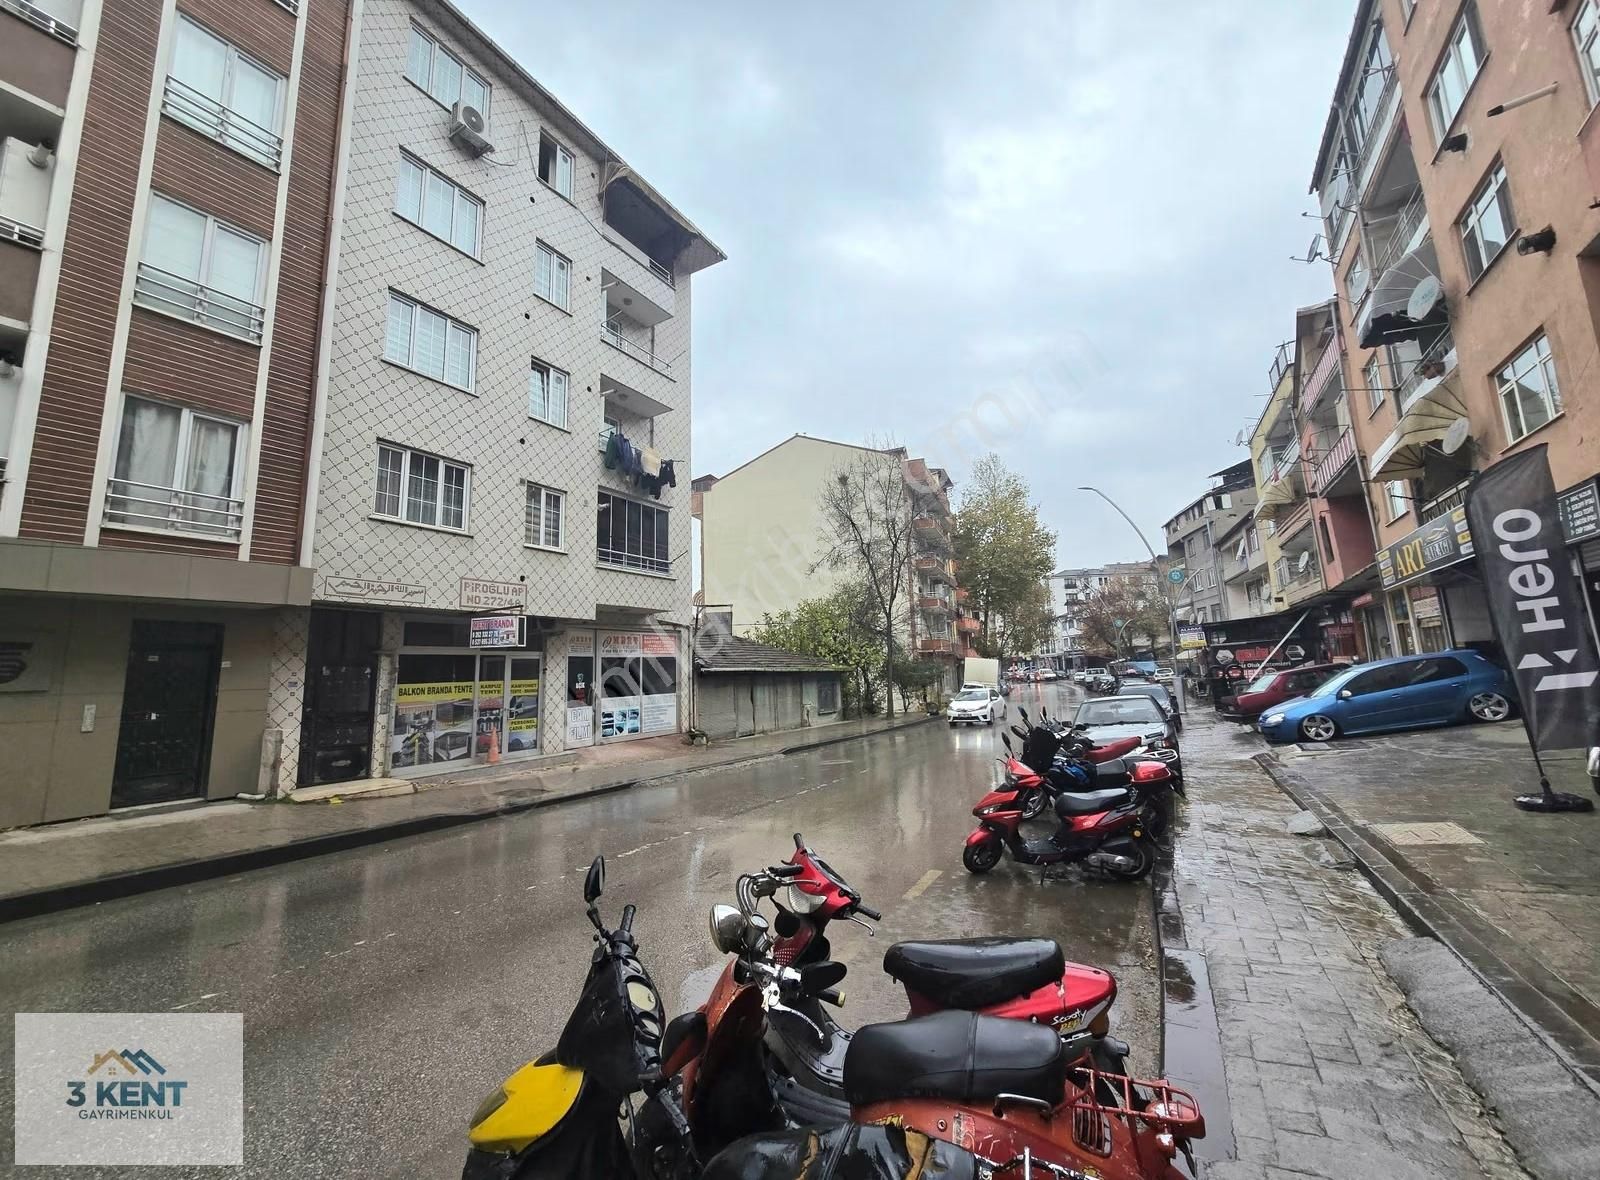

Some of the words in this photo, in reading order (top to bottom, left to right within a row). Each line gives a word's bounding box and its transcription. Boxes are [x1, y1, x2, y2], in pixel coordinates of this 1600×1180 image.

[1396, 537, 1426, 579] ART
[1492, 508, 1566, 633] Hero
[511, 587, 525, 597] AP
[466, 595, 481, 605] NO
[398, 687, 426, 697] BALKON
[427, 685, 452, 695] BRANDA
[453, 684, 473, 694] TENTE
[1051, 1008, 1087, 1026] Scooty
